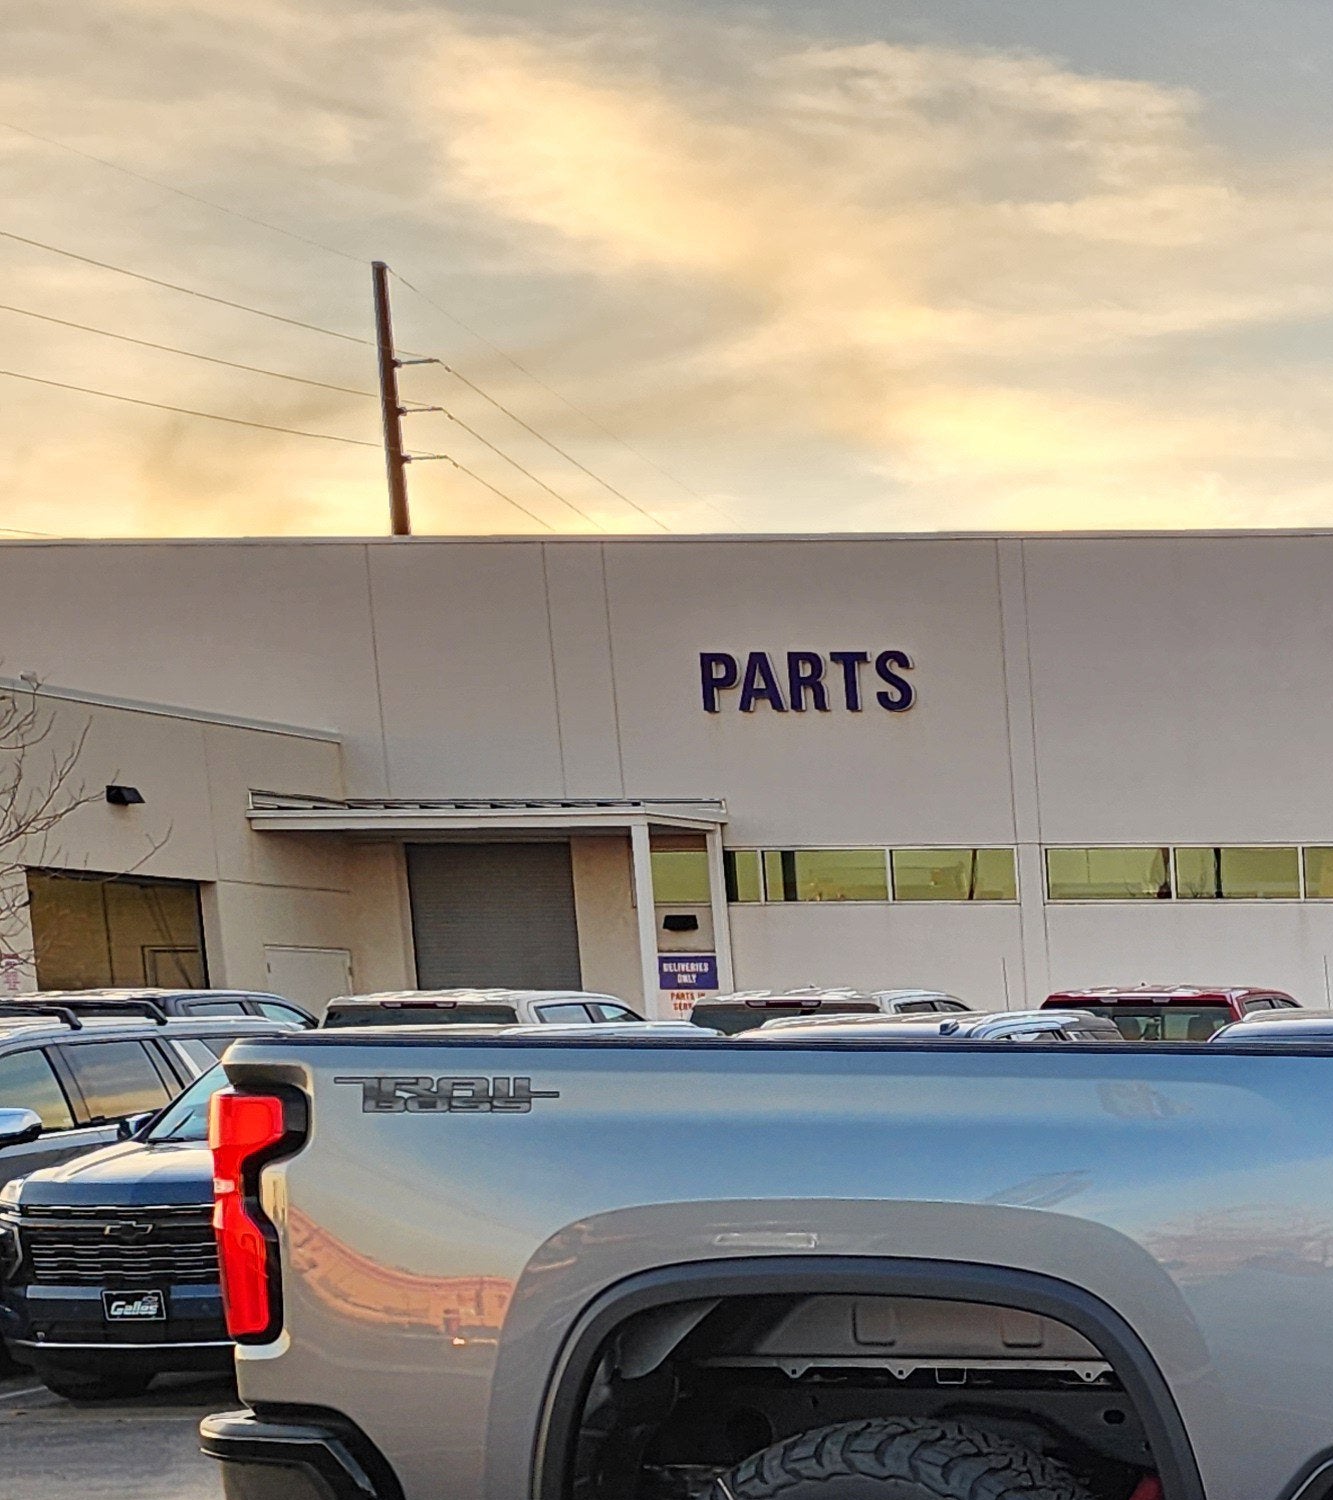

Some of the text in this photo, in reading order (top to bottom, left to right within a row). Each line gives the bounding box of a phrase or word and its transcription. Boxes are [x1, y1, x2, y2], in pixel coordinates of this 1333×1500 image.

[699, 650, 916, 712] PARTS
[662, 962, 709, 973] DELIVERIES
[677, 973, 697, 984] ONLY
[670, 992, 695, 1001] PARTS
[334, 1076, 560, 1099] TRAIL
[362, 1096, 532, 1113] BOSS
